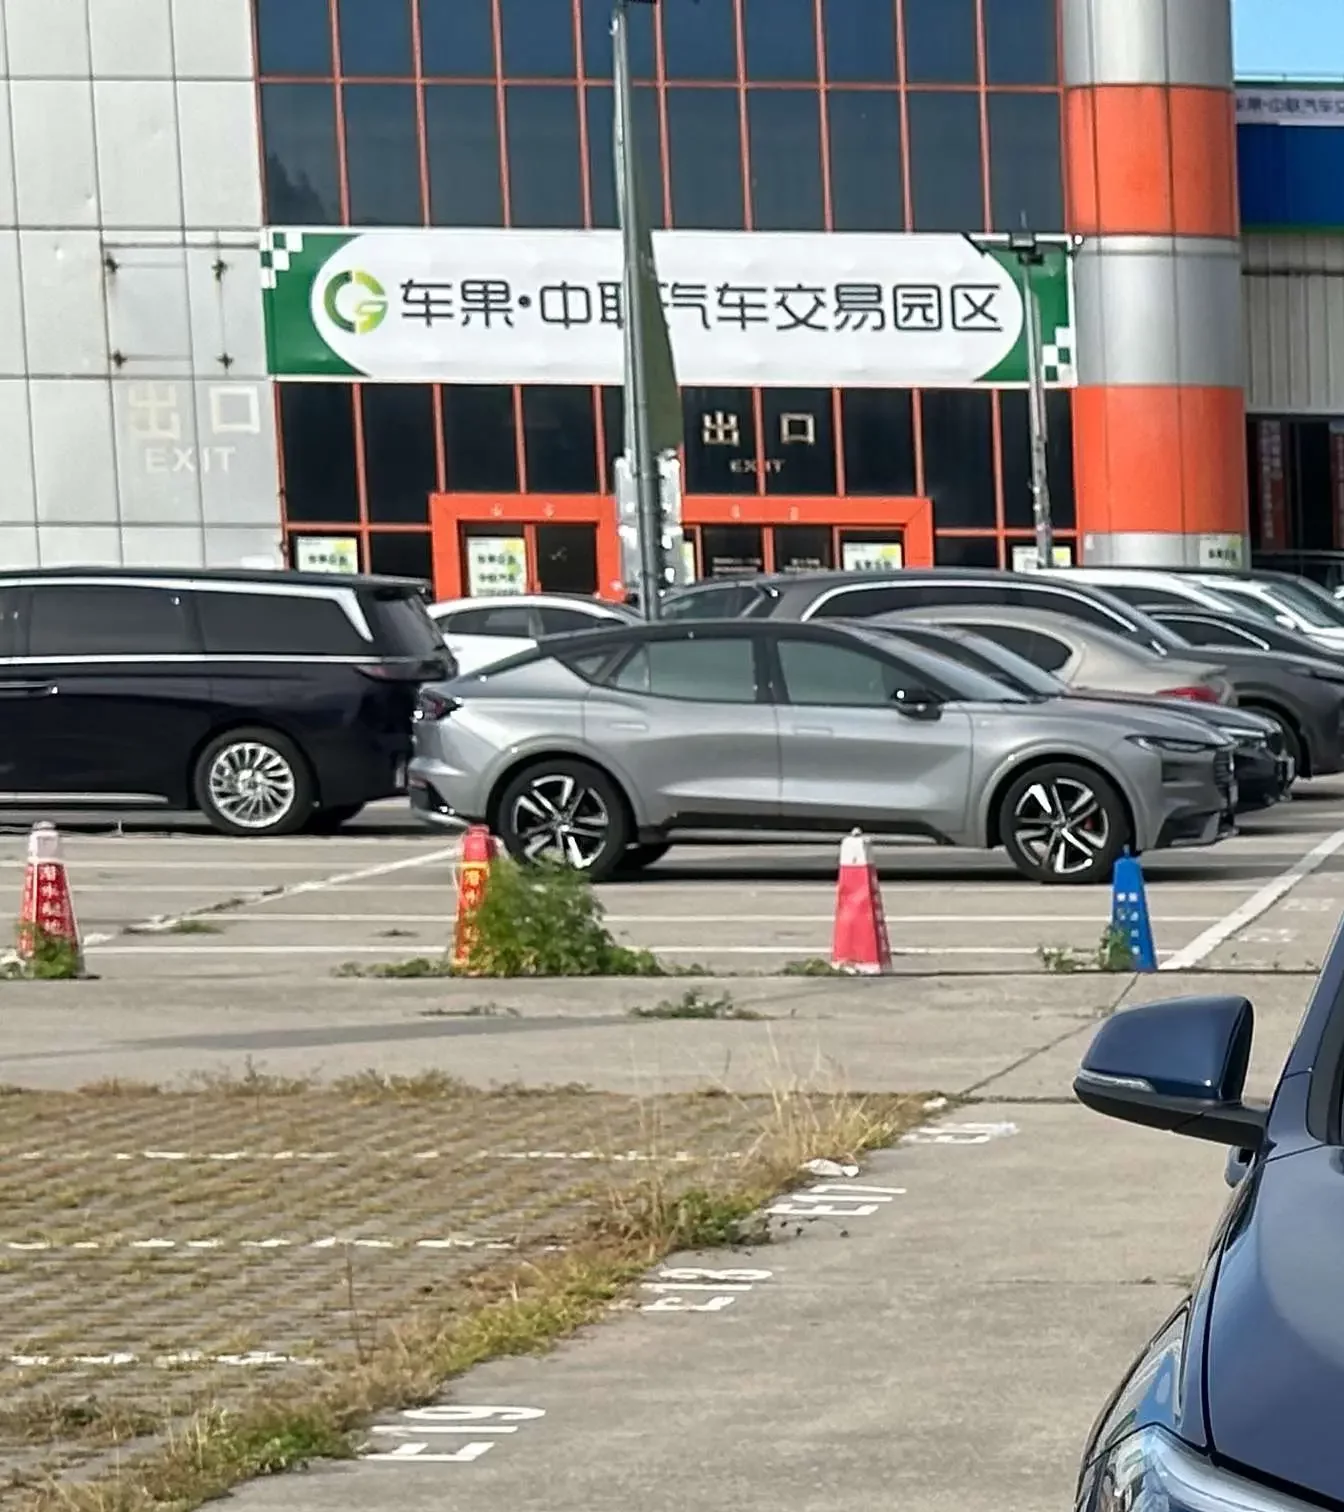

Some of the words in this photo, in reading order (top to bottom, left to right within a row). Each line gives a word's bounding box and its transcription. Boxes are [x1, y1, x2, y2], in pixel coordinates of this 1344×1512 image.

[128, 384, 261, 440] 出口
[702, 410, 816, 447] 出口
[145, 446, 236, 473] EXIT
